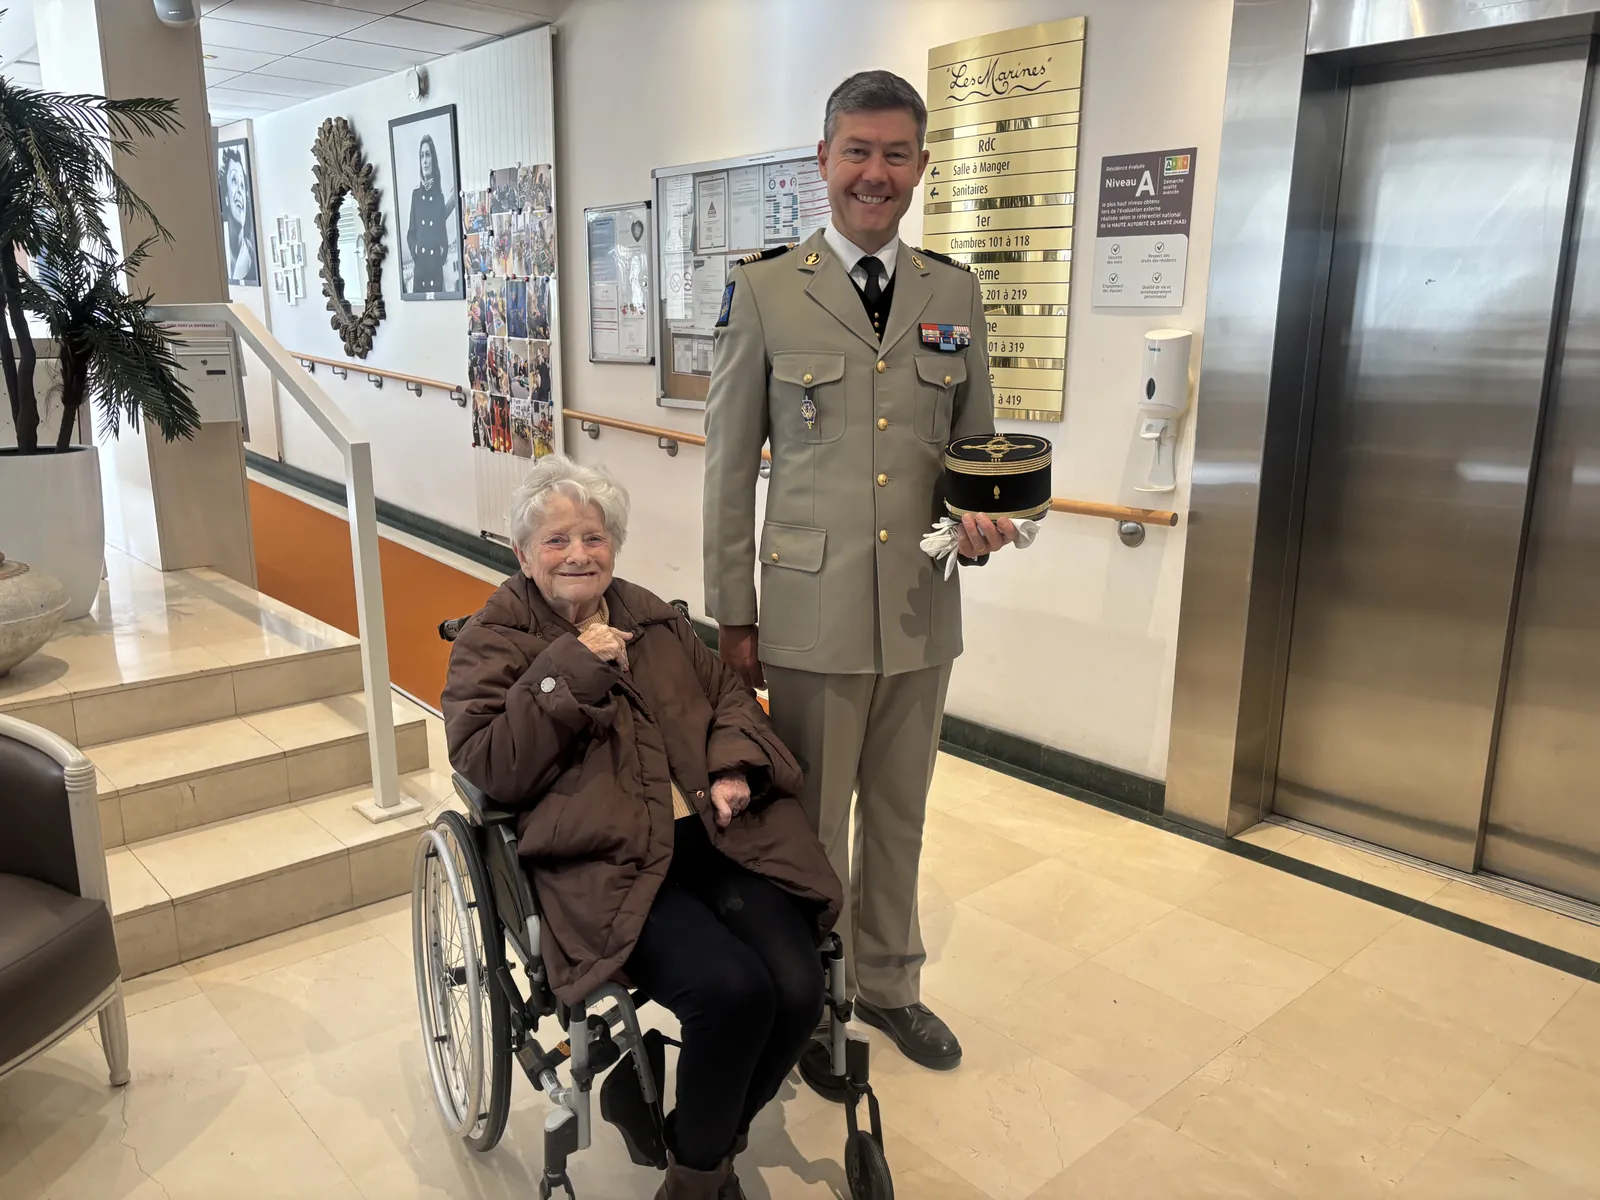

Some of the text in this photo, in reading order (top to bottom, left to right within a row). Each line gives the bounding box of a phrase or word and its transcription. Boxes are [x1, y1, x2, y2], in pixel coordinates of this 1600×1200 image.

[978, 137, 996, 152] RdC
[953, 161, 1010, 176] Salle à Manger
[952, 183, 988, 196] Sanitaires
[1106, 170, 1155, 197] Niveau A
[976, 215, 991, 227] 1er
[950, 235, 1030, 249] Chambres 101 à 118
[986, 290, 1000, 300] 201
[1003, 289, 1008, 300] à
[1012, 289, 1027, 300] 219
[988, 341, 1024, 352] 01 à 319
[998, 393, 1022, 405] à 419
